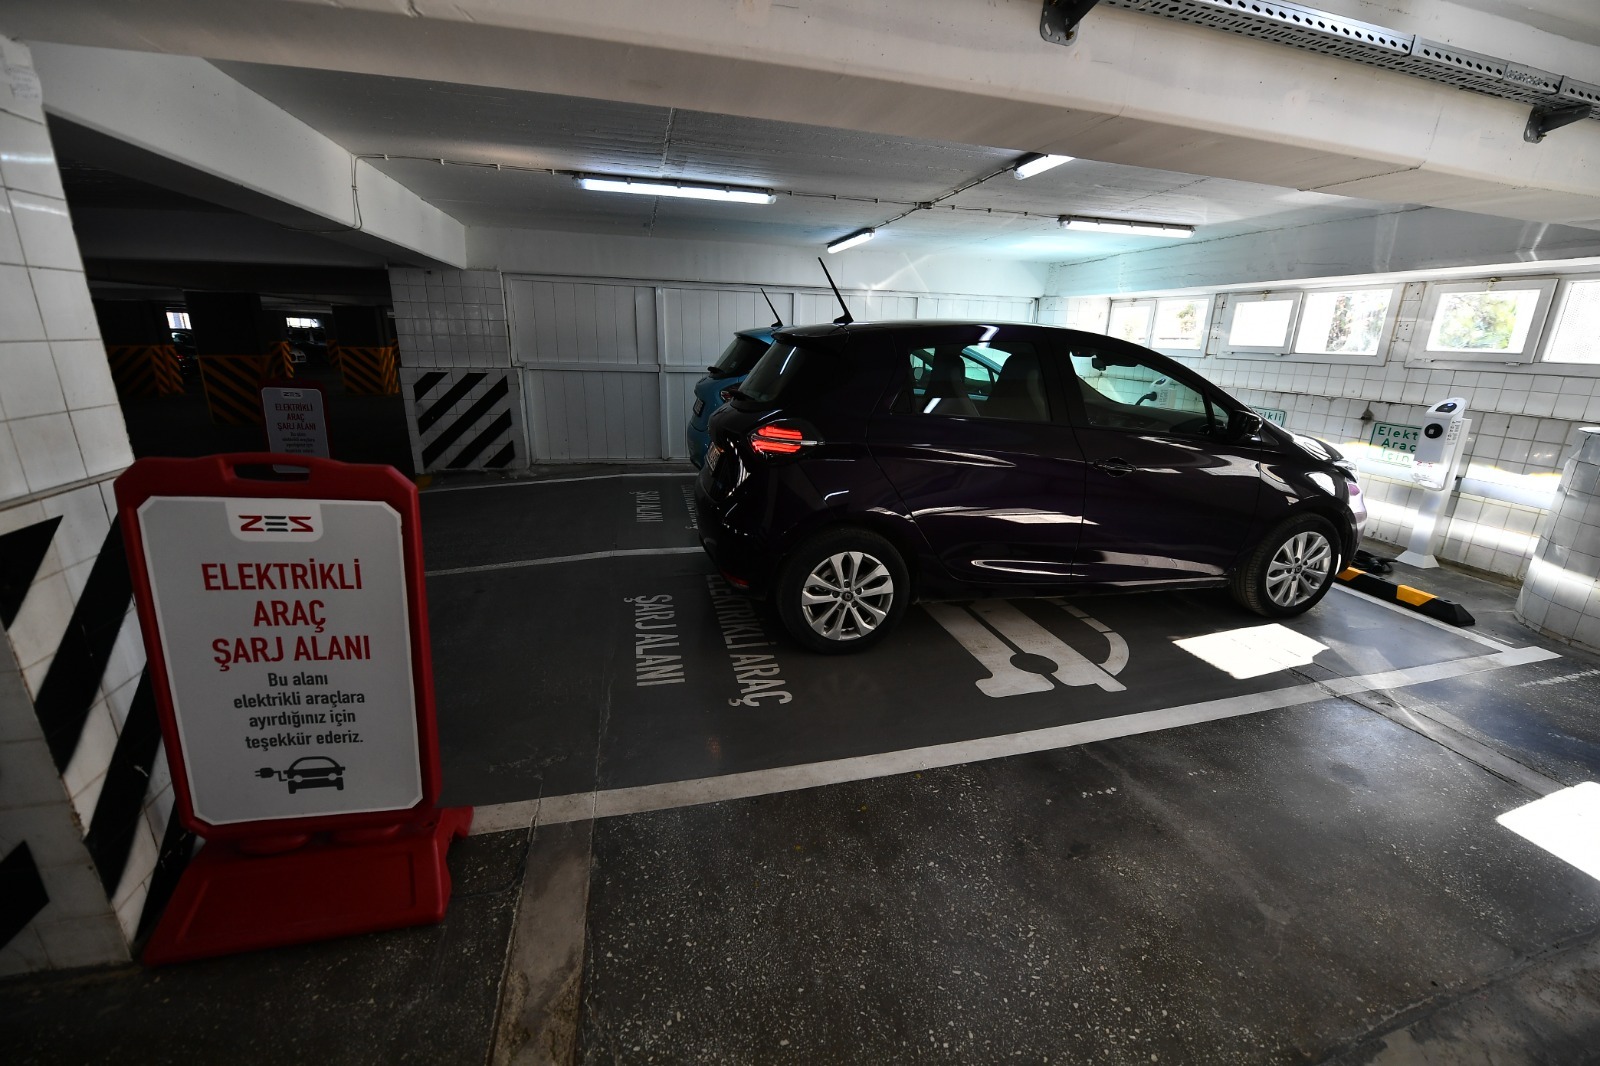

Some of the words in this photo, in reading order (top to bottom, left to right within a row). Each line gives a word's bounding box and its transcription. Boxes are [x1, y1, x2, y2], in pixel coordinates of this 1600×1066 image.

[1377, 425, 1419, 441] Elekt
[238, 515, 314, 532] ZES
[201, 558, 363, 591] ELEKTRİKLİ
[253, 599, 327, 633] ARAÇ
[623, 594, 677, 630] ŞARJ
[211, 636, 285, 672] ŞARJ
[294, 635, 371, 661] ALANI
[635, 633, 686, 687] ALANI
[267, 672, 289, 687] Bu
[293, 672, 328, 687] alanı
[728, 654, 793, 707] ARAÇ
[233, 692, 301, 709] elektrikli
[305, 691, 366, 709] araçlara
[249, 711, 326, 729] ayırdığınız
[330, 710, 356, 728] için
[245, 732, 312, 751] teşekkür
[316, 731, 364, 746] ederiz.
